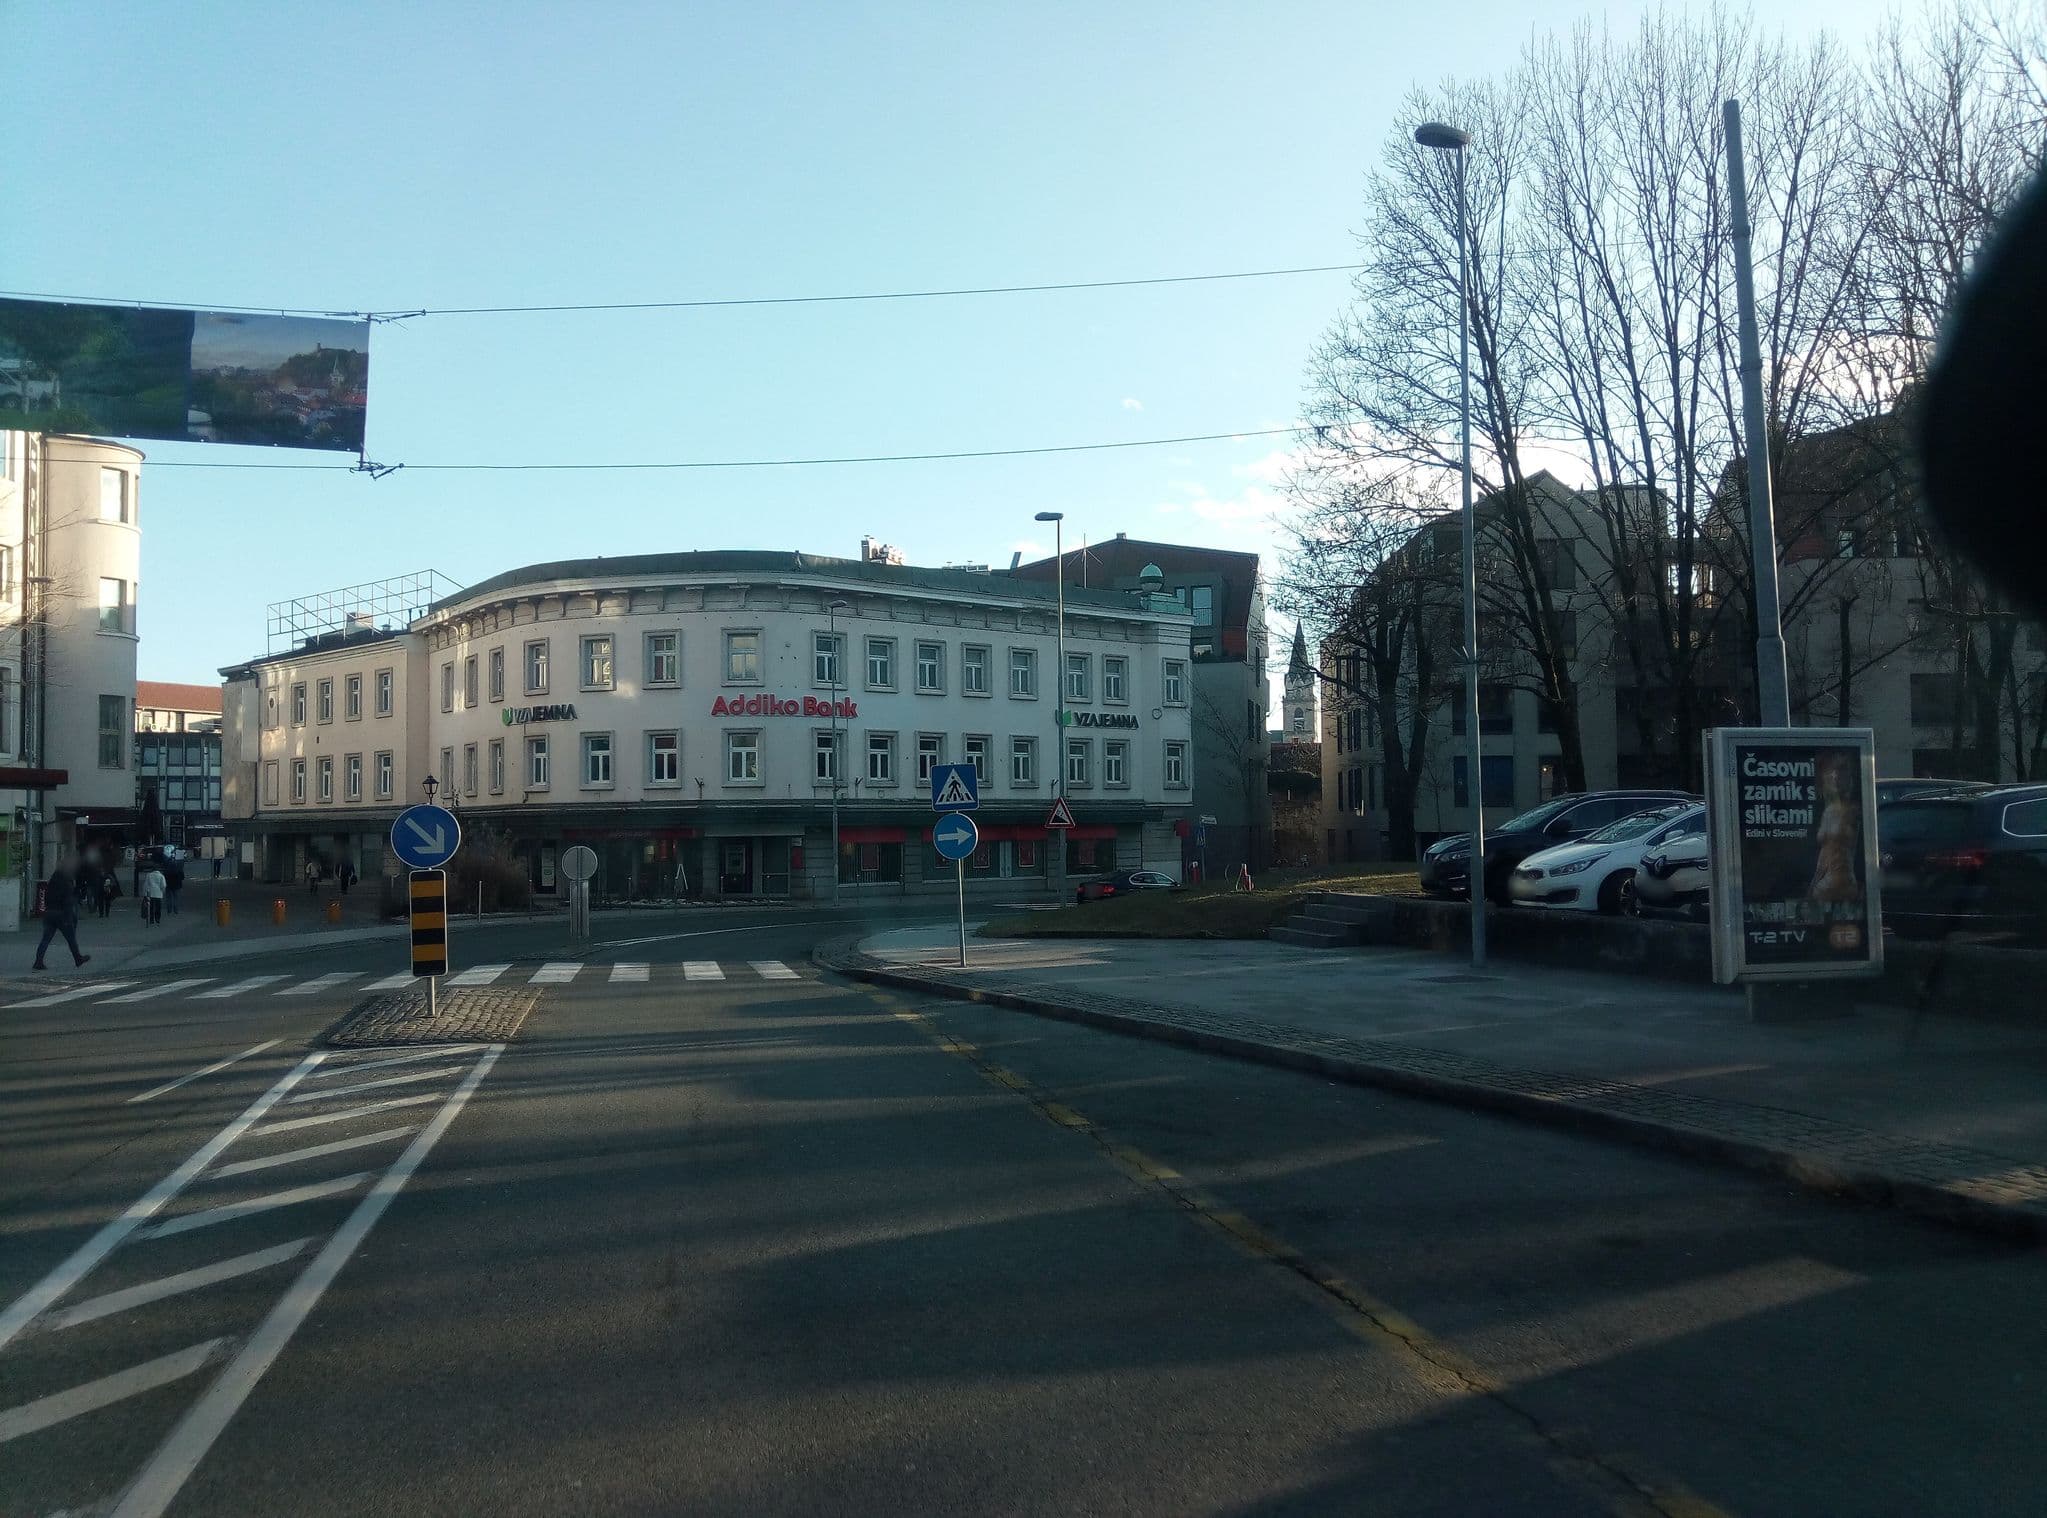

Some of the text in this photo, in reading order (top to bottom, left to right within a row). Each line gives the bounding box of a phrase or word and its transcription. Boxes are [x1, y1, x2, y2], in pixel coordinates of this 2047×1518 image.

[514, 704, 578, 723] VZAJEMNA
[711, 694, 858, 718] Addiko Bank
[1073, 712, 1139, 728] VZAJEMNA
[1743, 752, 1815, 777] Časovni
[1744, 780, 1816, 800] zamik s
[1745, 805, 1813, 824] slikami
[1745, 828, 1765, 838] Edini
[1779, 930, 1807, 943] TV
